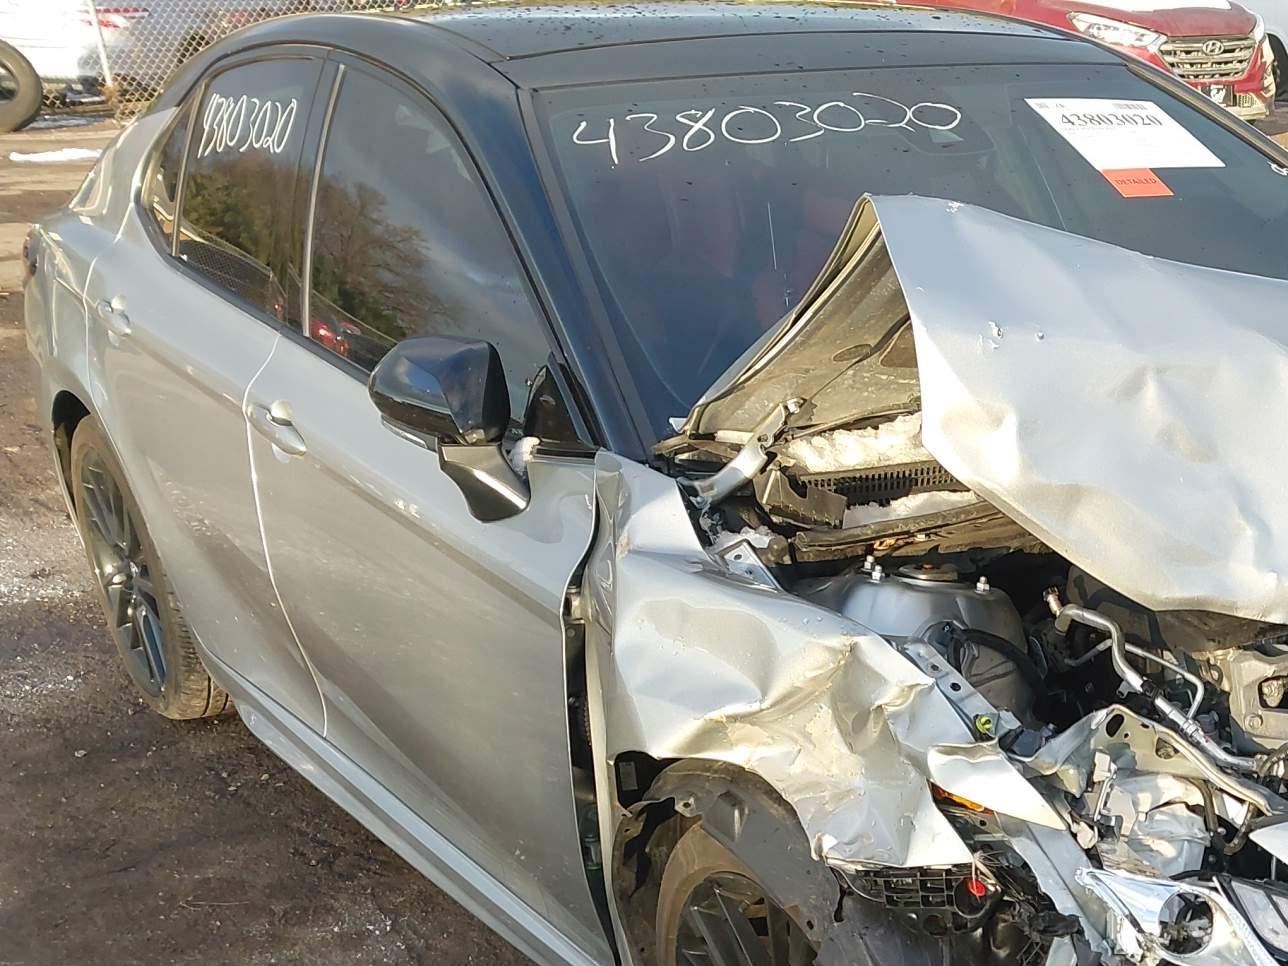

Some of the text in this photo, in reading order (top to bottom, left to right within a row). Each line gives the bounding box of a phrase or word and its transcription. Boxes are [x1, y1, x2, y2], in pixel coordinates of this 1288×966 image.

[198, 93, 297, 158] 43803020
[572, 92, 961, 165] 43803020
[1061, 113, 1162, 126] 43803020
[1114, 177, 1157, 185] DETAILED
